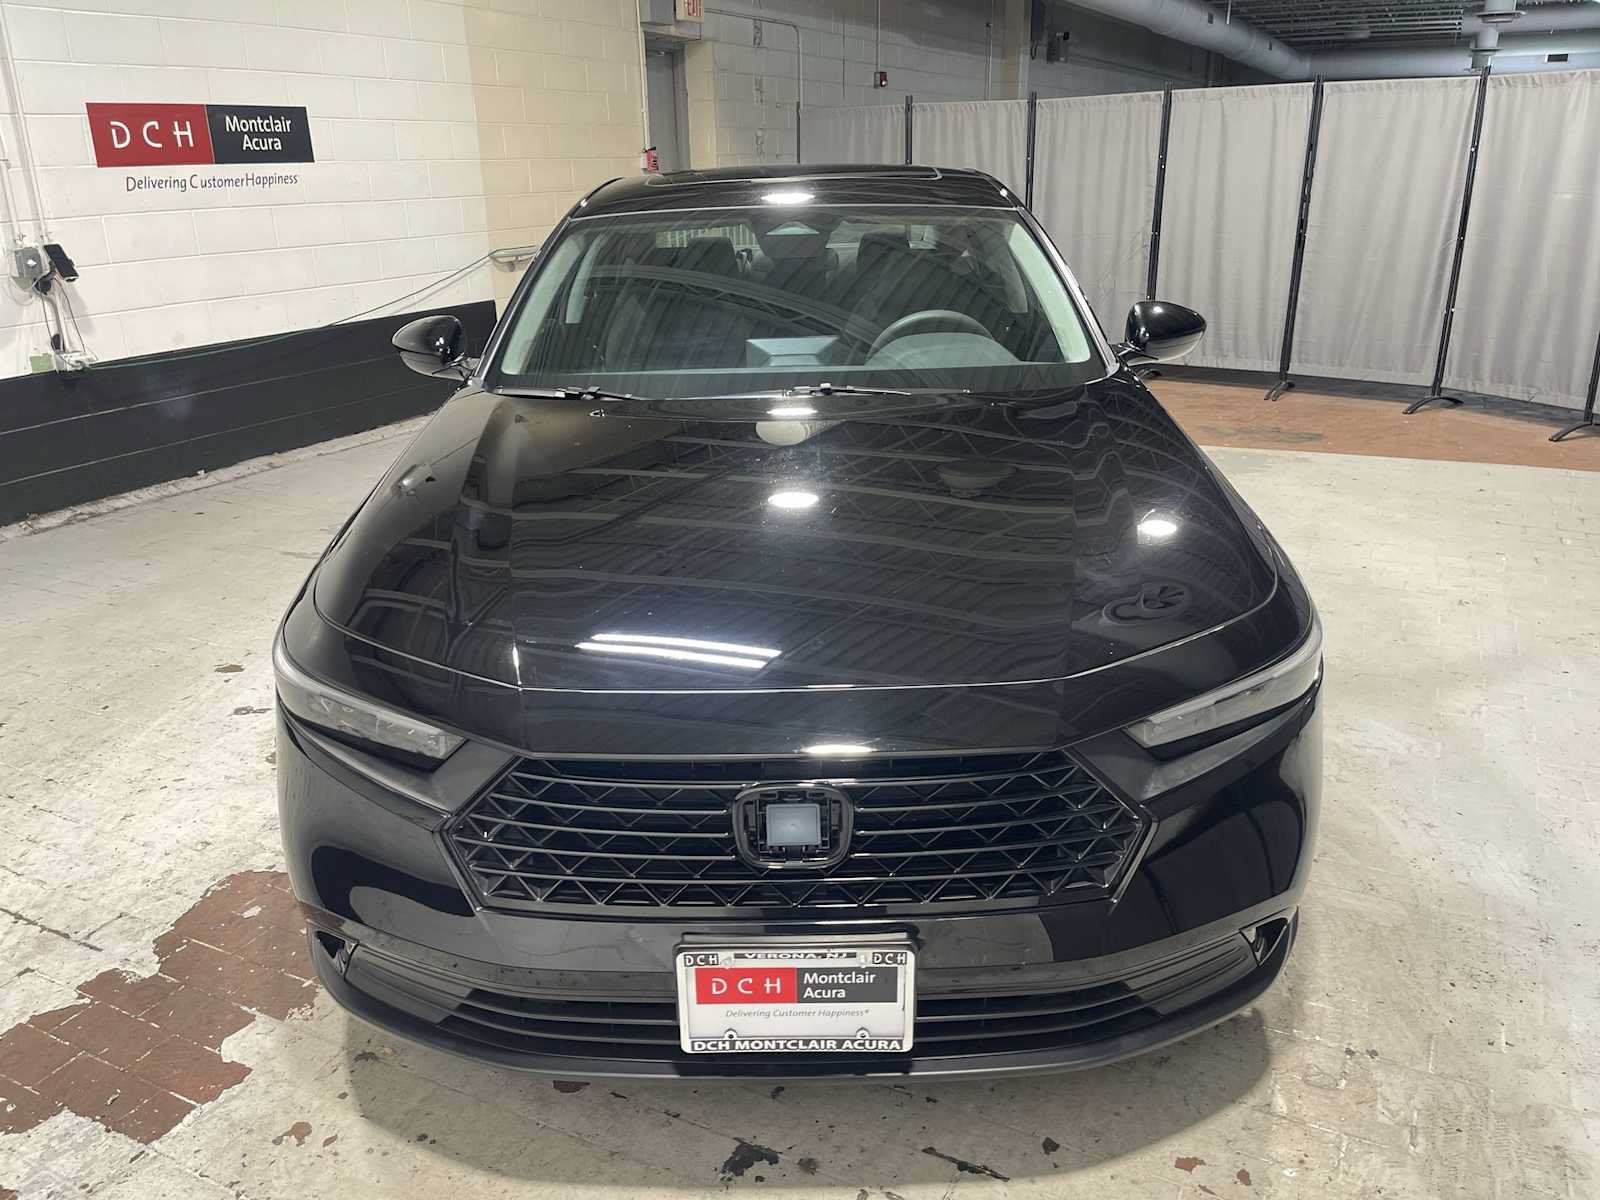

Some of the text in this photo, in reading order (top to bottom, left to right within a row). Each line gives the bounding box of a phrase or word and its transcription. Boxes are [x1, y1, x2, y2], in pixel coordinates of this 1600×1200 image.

[225, 115, 292, 132] Montclair
[242, 134, 282, 151] Acura
[126, 176, 187, 192] Delivering
[803, 971, 877, 985] Montclair
[803, 987, 846, 999] Acura
[725, 1009, 771, 1019] Delivering
[772, 1008, 816, 1017] Customer
[693, 1039, 901, 1051] DCH MONTCLAIR ACURA
